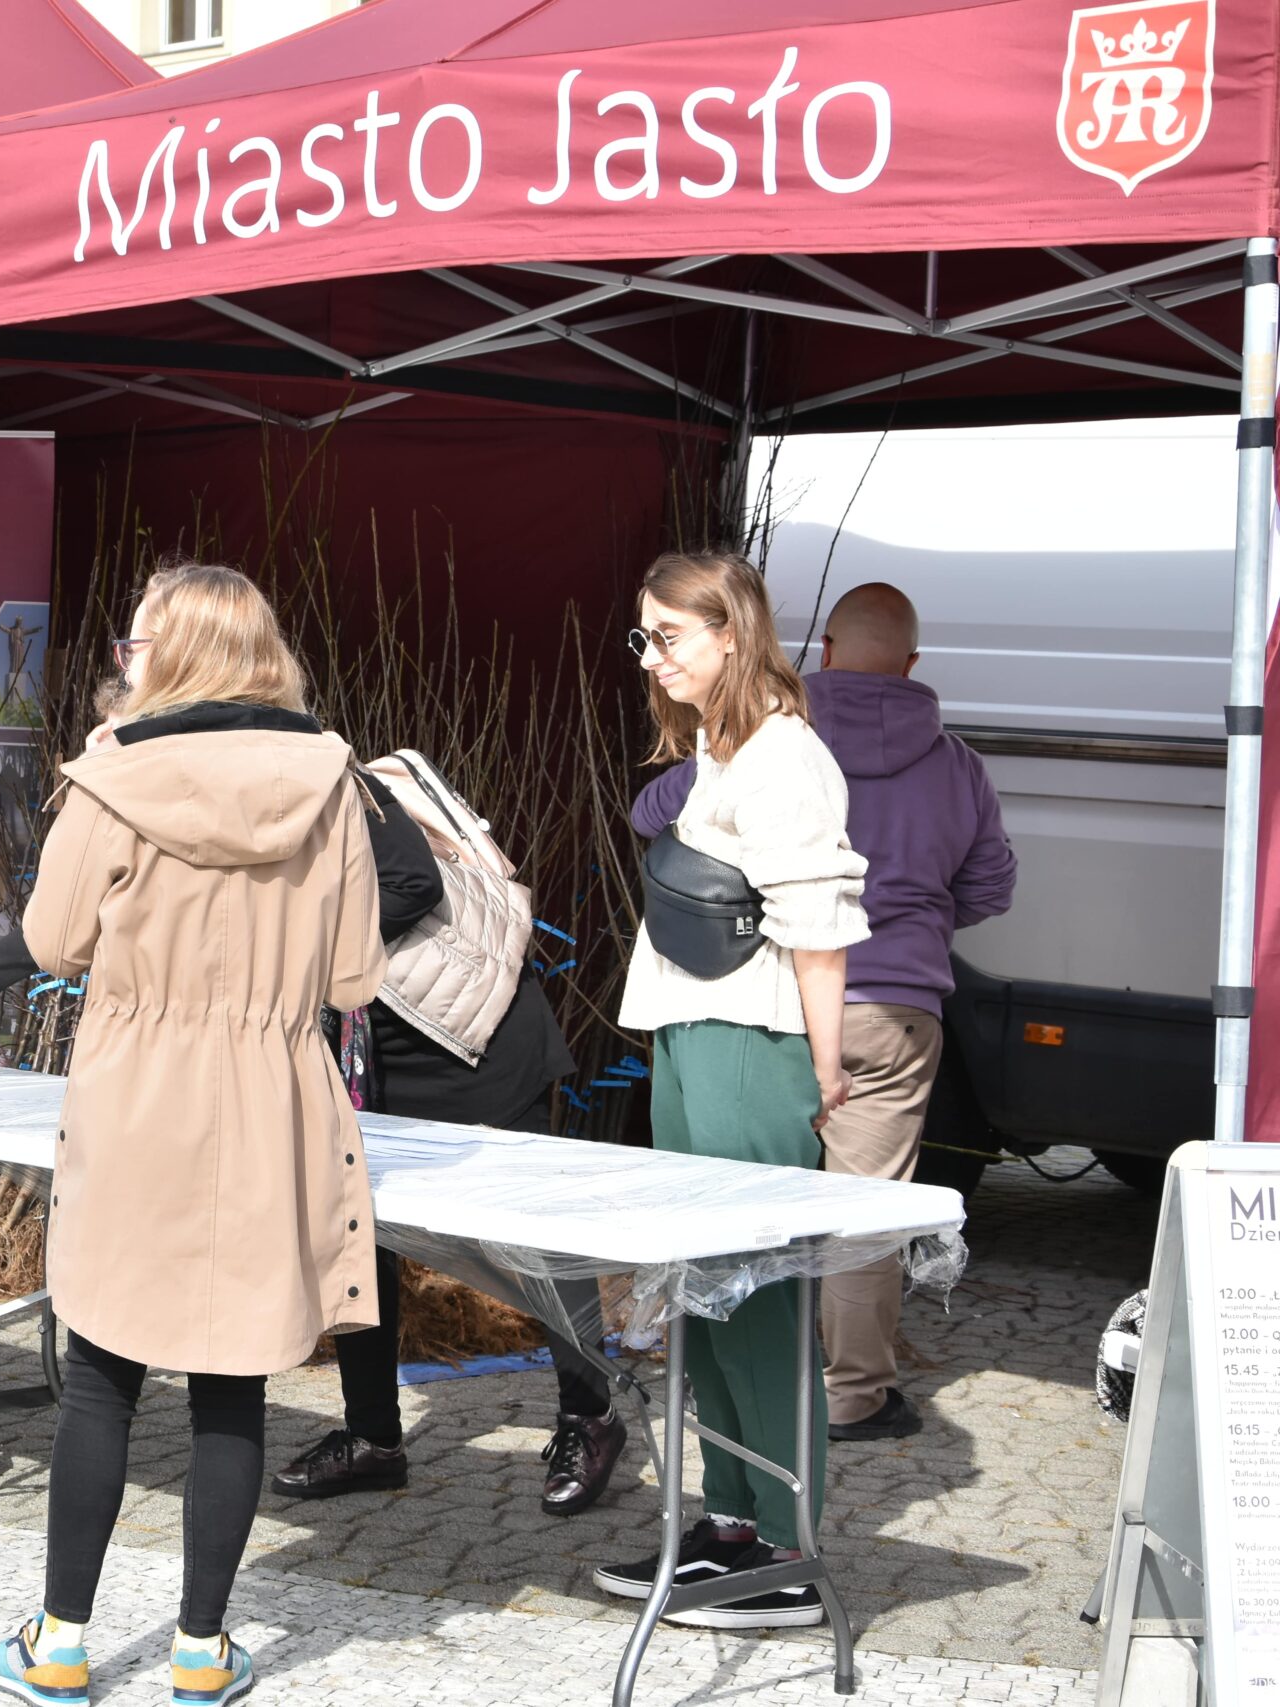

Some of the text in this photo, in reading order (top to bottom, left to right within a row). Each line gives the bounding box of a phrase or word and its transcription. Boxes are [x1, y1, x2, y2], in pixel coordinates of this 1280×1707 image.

[74, 91, 483, 262] Miasto
[527, 47, 891, 205] Jasło
[1219, 1288, 1257, 1300] 12.00
[1222, 1328, 1259, 1340] 12.00
[1222, 1345, 1262, 1356] pytanie
[1224, 1364, 1259, 1376] 15.45
[1227, 1423, 1261, 1436] 16.15
[1232, 1496, 1271, 1508] 18.00
